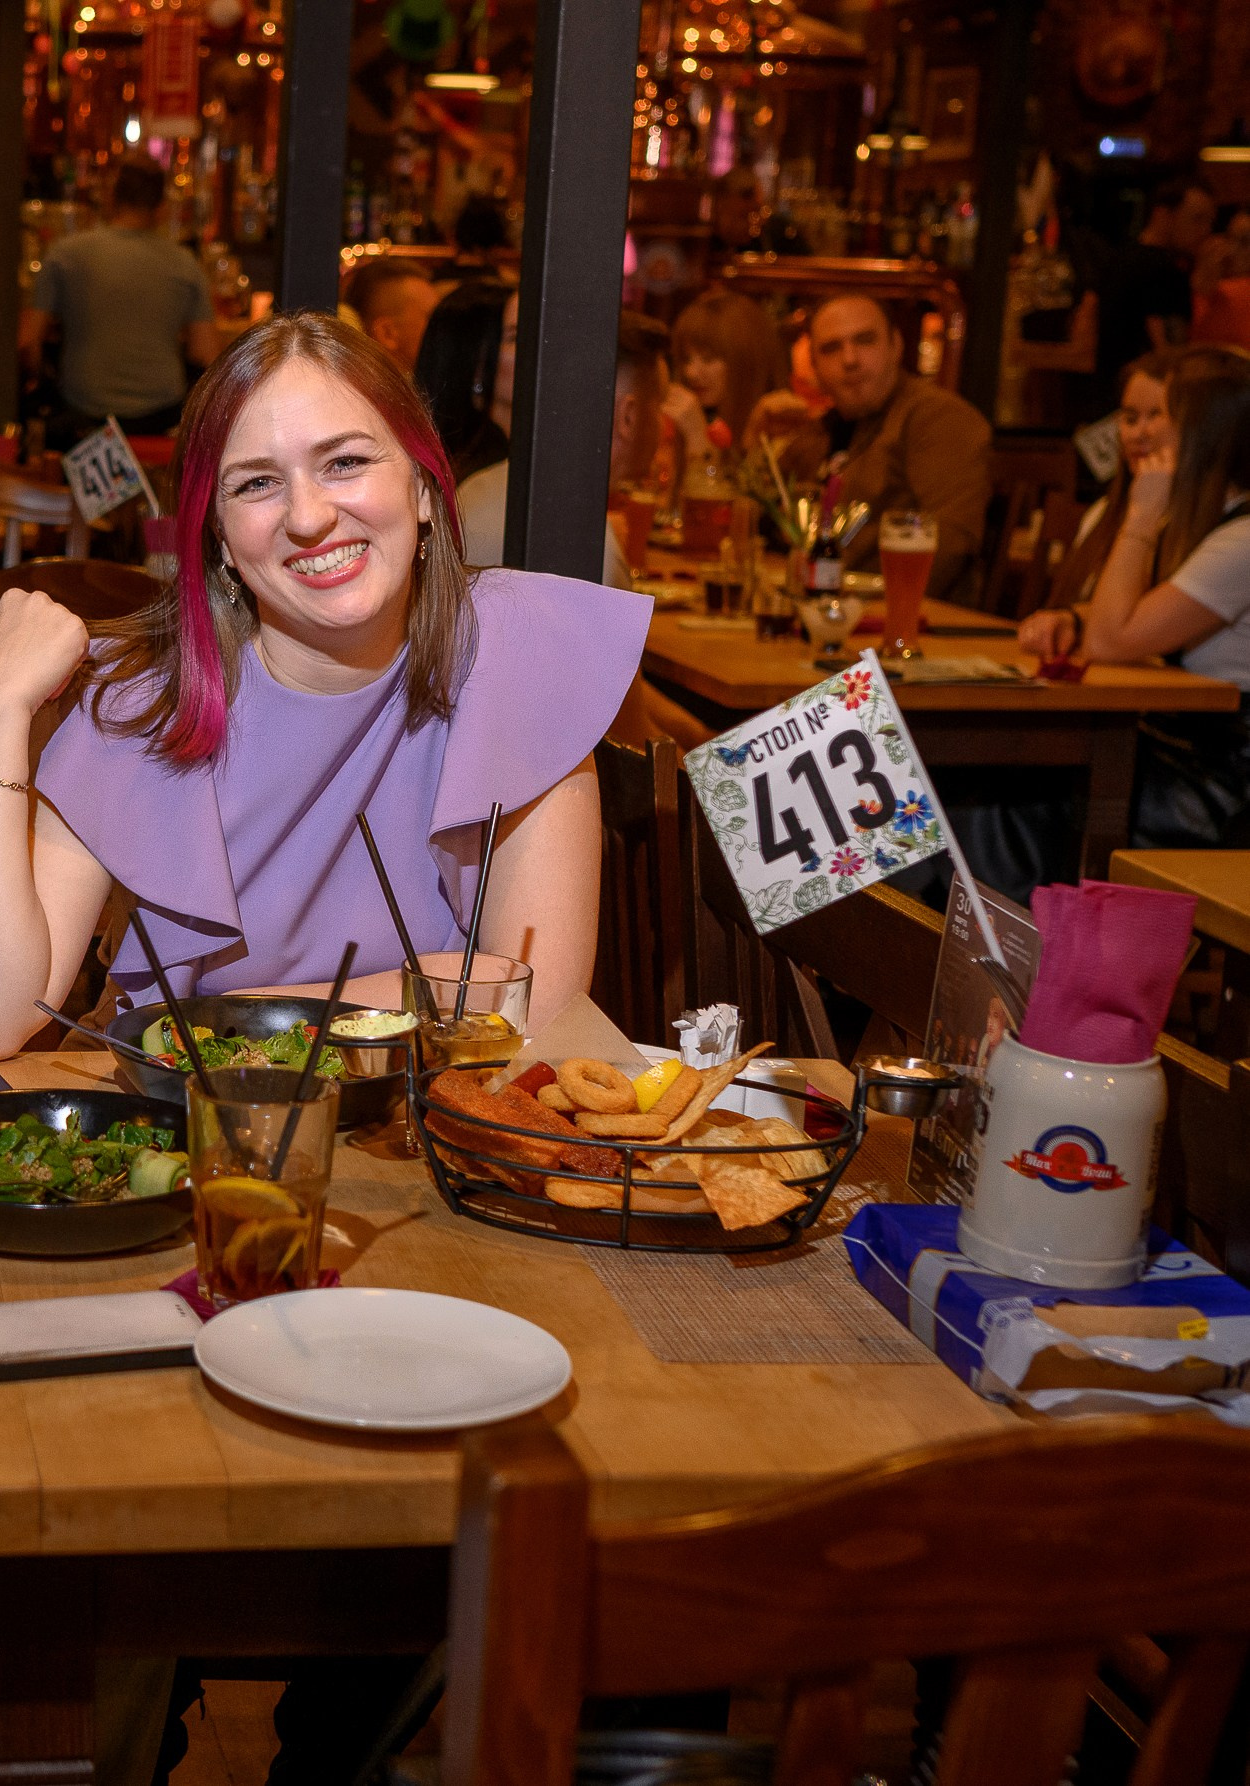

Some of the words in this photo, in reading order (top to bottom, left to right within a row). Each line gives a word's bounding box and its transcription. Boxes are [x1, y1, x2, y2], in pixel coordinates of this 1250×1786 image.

[79, 448, 130, 498] 414
[750, 717, 804, 764] СТОЛ
[752, 729, 898, 865] 413
[956, 892, 973, 915] 30
